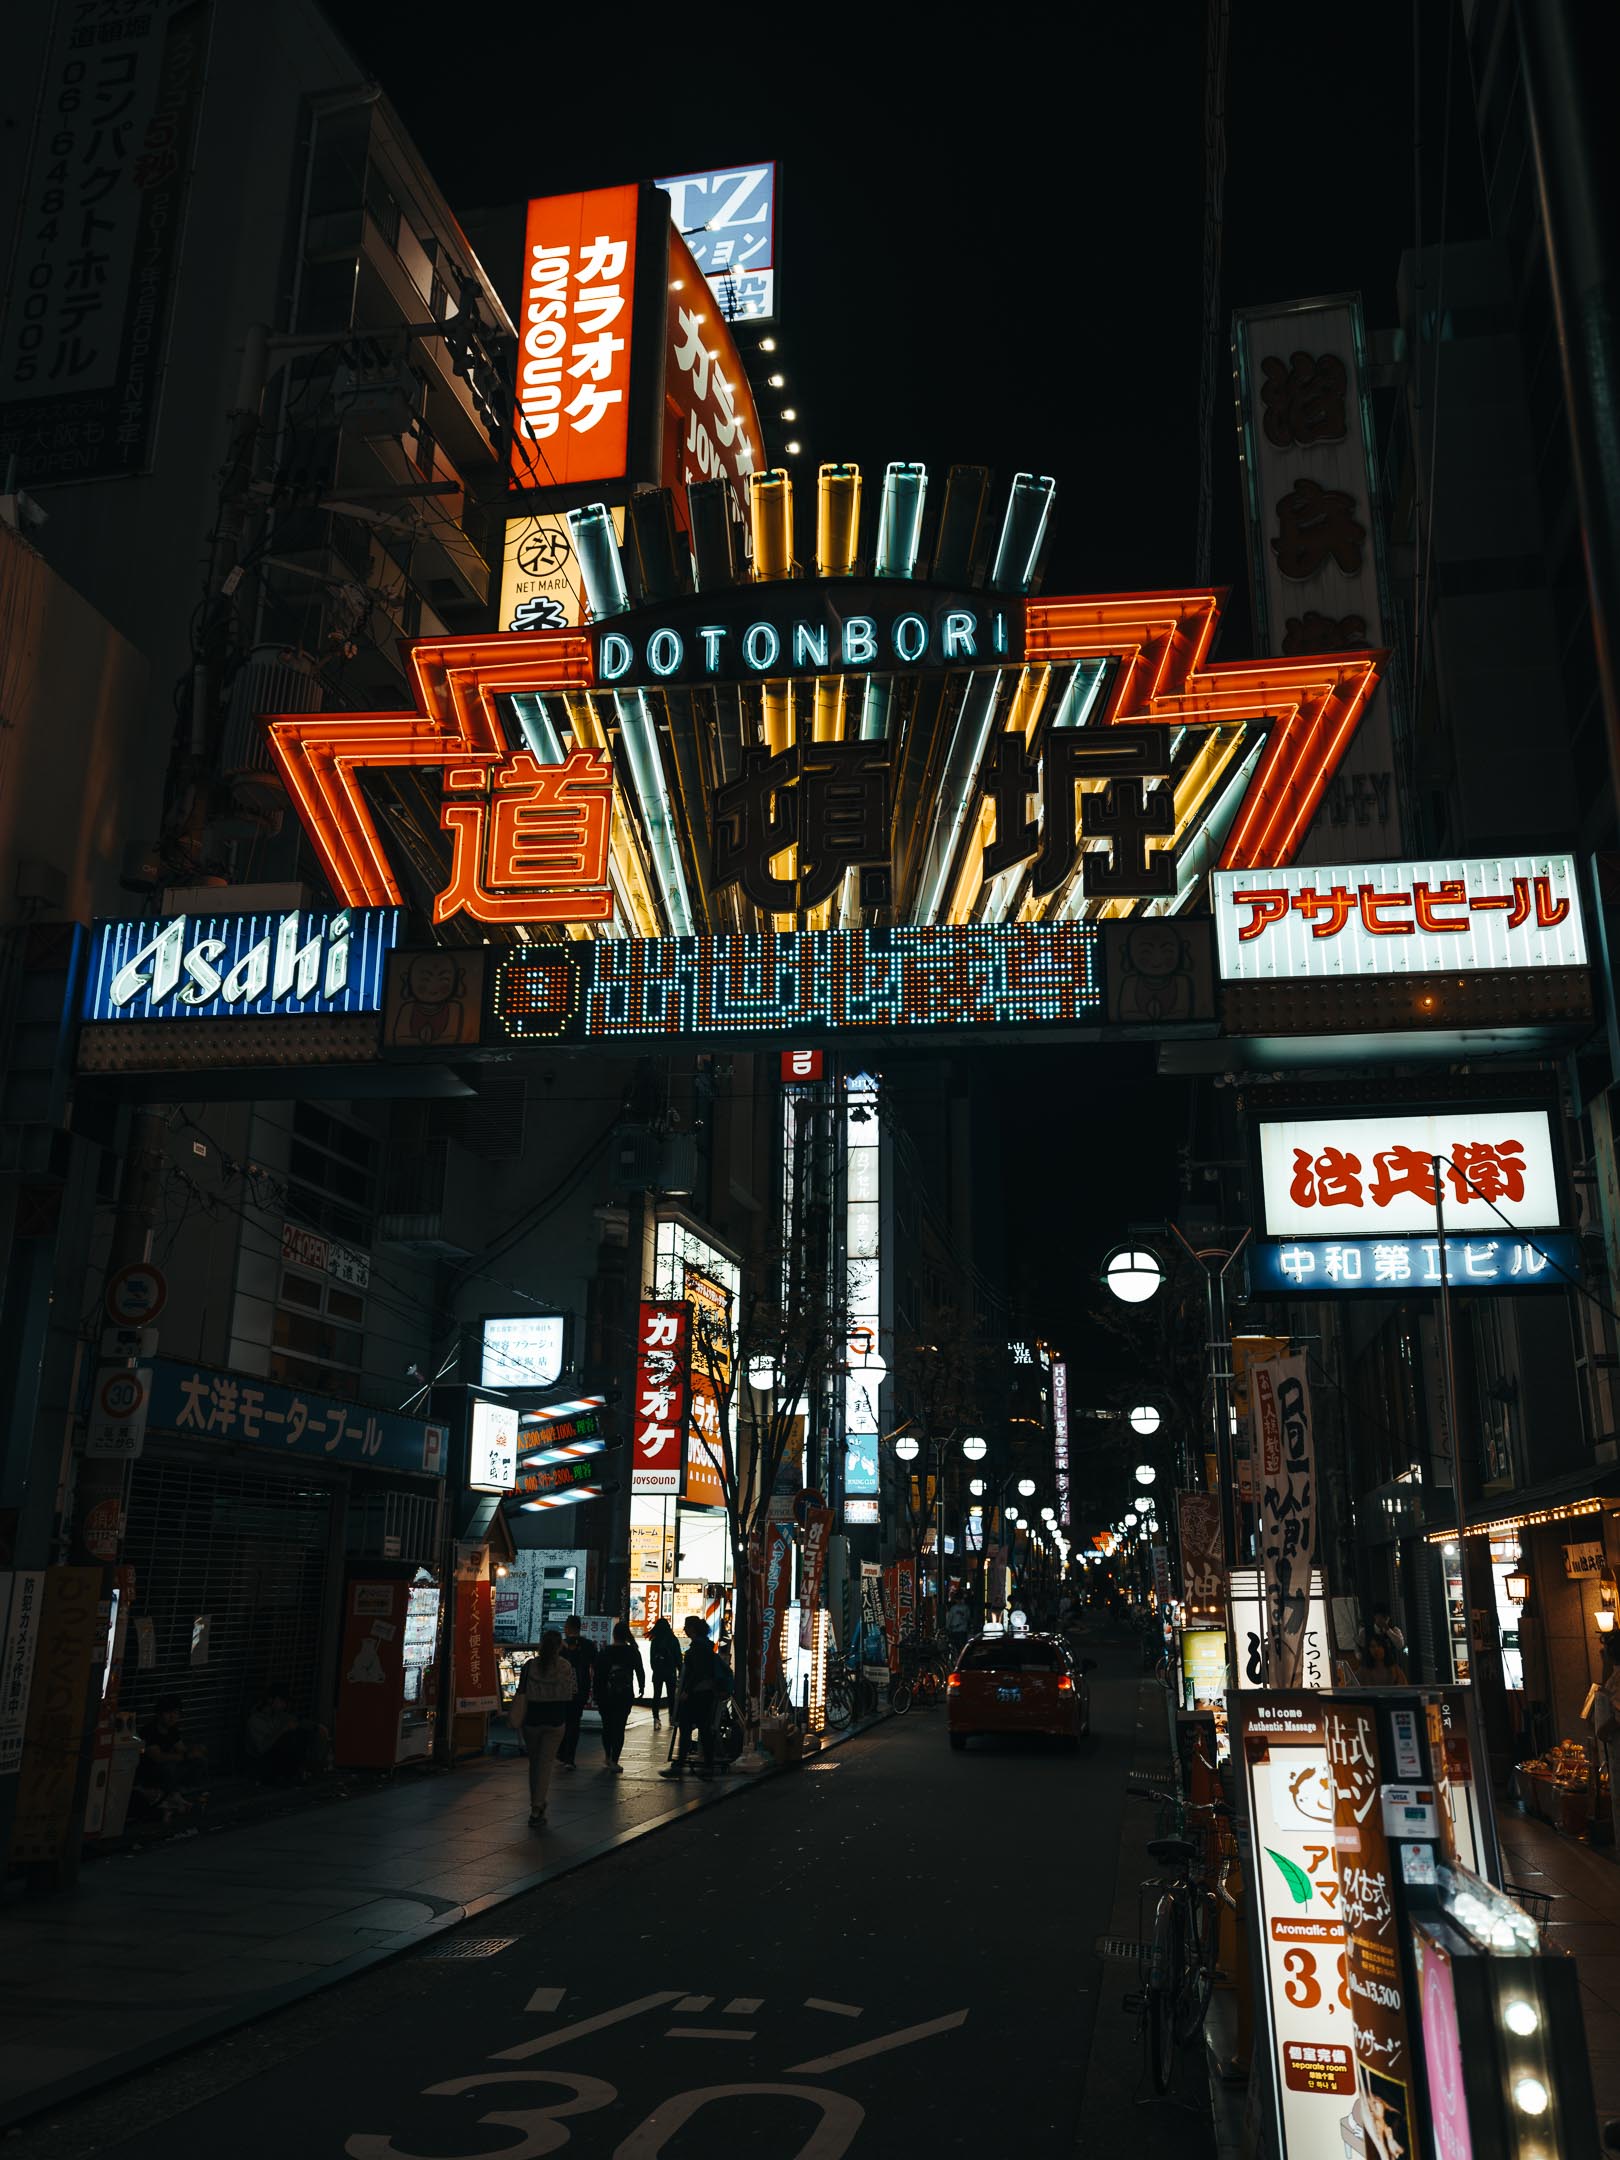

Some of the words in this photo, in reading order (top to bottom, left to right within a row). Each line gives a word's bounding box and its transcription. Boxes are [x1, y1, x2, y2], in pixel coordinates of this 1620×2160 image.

[15, 62, 85, 382] 06-6484-0005
[49, 52, 138, 379] コンパクトホテル
[519, 245, 571, 440] JOYSOUND
[563, 235, 628, 434] カラオケ
[516, 581, 535, 594] NET
[538, 578, 568, 591] MARU
[601, 609, 1008, 681] DOTONBORI
[433, 724, 1178, 926] 道頓堀
[1233, 877, 1571, 941] アサヒビール
[110, 909, 351, 1007] Asahi
[1290, 1139, 1527, 1208] 治兵衛
[110, 1385, 135, 1406] 30
[175, 1372, 384, 1457] 太洋モータープール
[425, 1429, 441, 1467] P
[638, 1313, 678, 1458] カラオケ
[1054, 1367, 1065, 1418] HOTEL
[632, 1475, 676, 1486] JOYSOUND
[1248, 1720, 1284, 1733] Authentic
[1284, 1721, 1317, 1733] Massage
[1257, 1707, 1303, 1719] Welcome
[1391, 1793, 1408, 1801] VISA
[1275, 1922, 1328, 1937] Aromatic
[1329, 1922, 1345, 1938] oil
[486, 1986, 971, 2075] ゾーン
[1288, 2045, 1348, 2064] 個室完備
[1291, 2061, 1325, 2073] separate
[1325, 2062, 1348, 2073] room
[344, 2069, 867, 2160] 30
